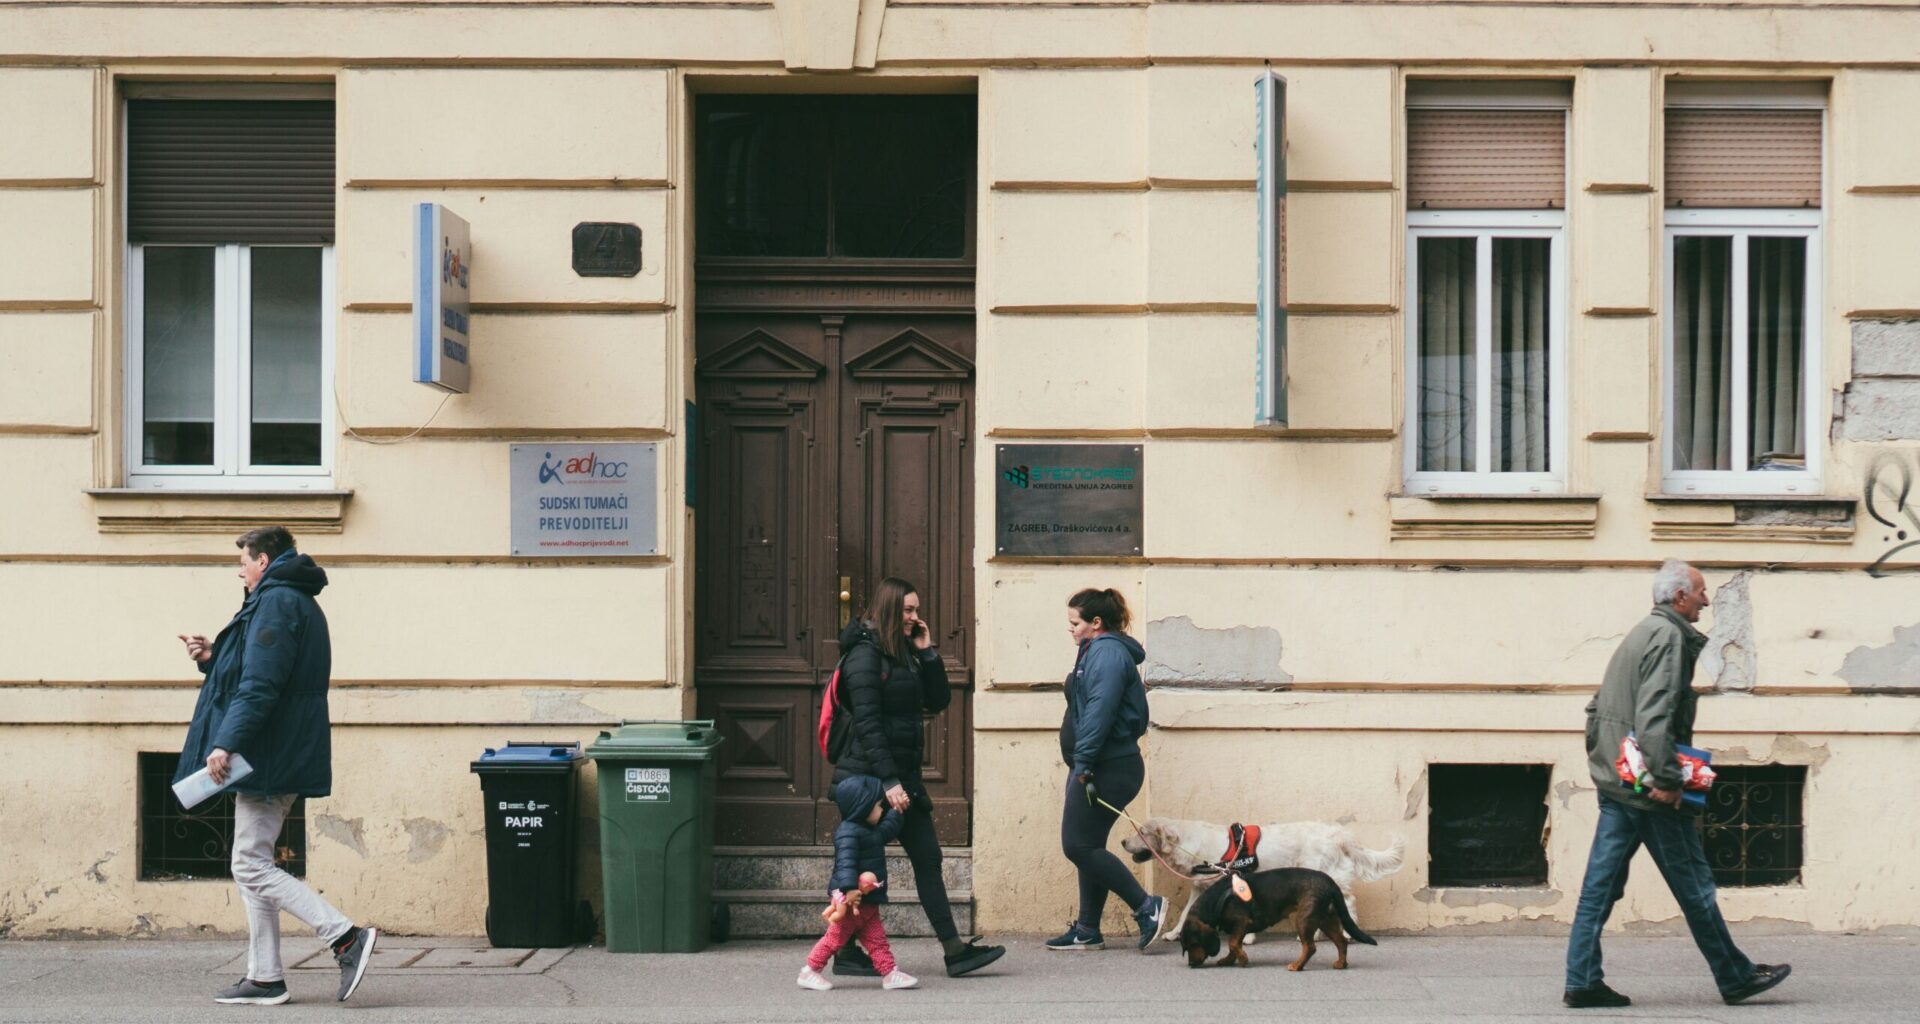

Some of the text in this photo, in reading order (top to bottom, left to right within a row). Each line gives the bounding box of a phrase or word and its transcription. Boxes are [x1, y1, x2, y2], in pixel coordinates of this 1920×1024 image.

[565, 451, 628, 478] adhoc
[539, 493, 629, 511] SUDSKI TUMAČI
[539, 516, 629, 531] PREVODITELJI
[1008, 523, 1050, 533] ZAGREB,
[1115, 523, 1122, 533] 4
[539, 539, 630, 548] www.adhocprijevodi.net
[627, 782, 670, 794] ČISTOĆA
[505, 815, 543, 828] PAPIR
